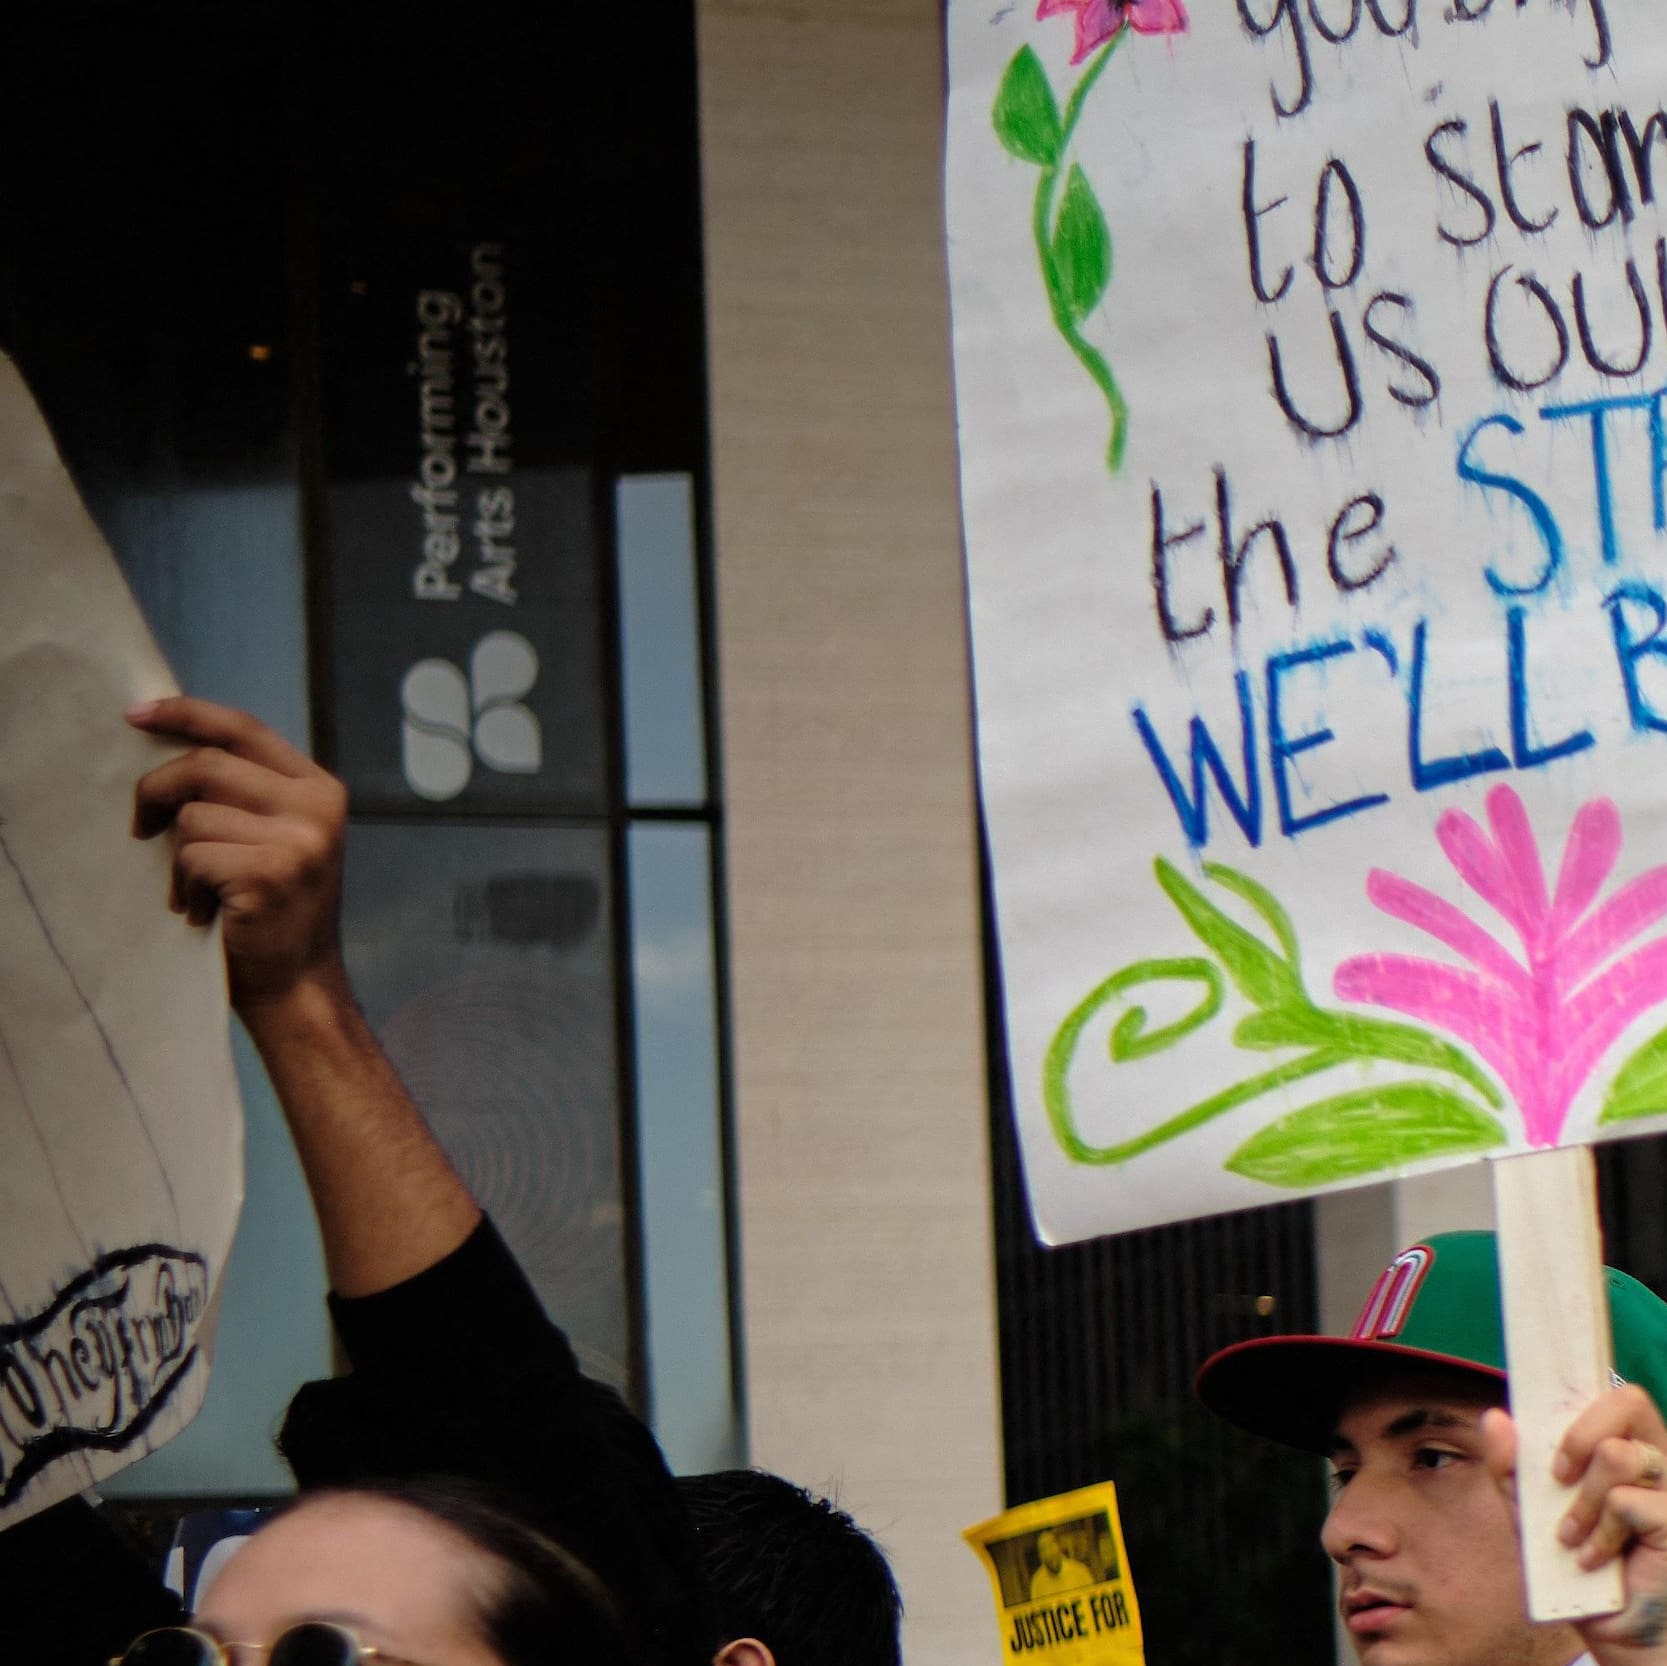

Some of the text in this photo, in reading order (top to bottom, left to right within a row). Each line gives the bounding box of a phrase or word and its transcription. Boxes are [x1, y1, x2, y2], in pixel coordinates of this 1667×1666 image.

[1242, 137, 1364, 305] to
[412, 288, 463, 600] Performing
[467, 243, 516, 604] Arts Houston
[1149, 467, 1395, 643] the
[1132, 605, 1595, 850] WE'LL
[1010, 1590, 1129, 1653] JUSTICE FOR
